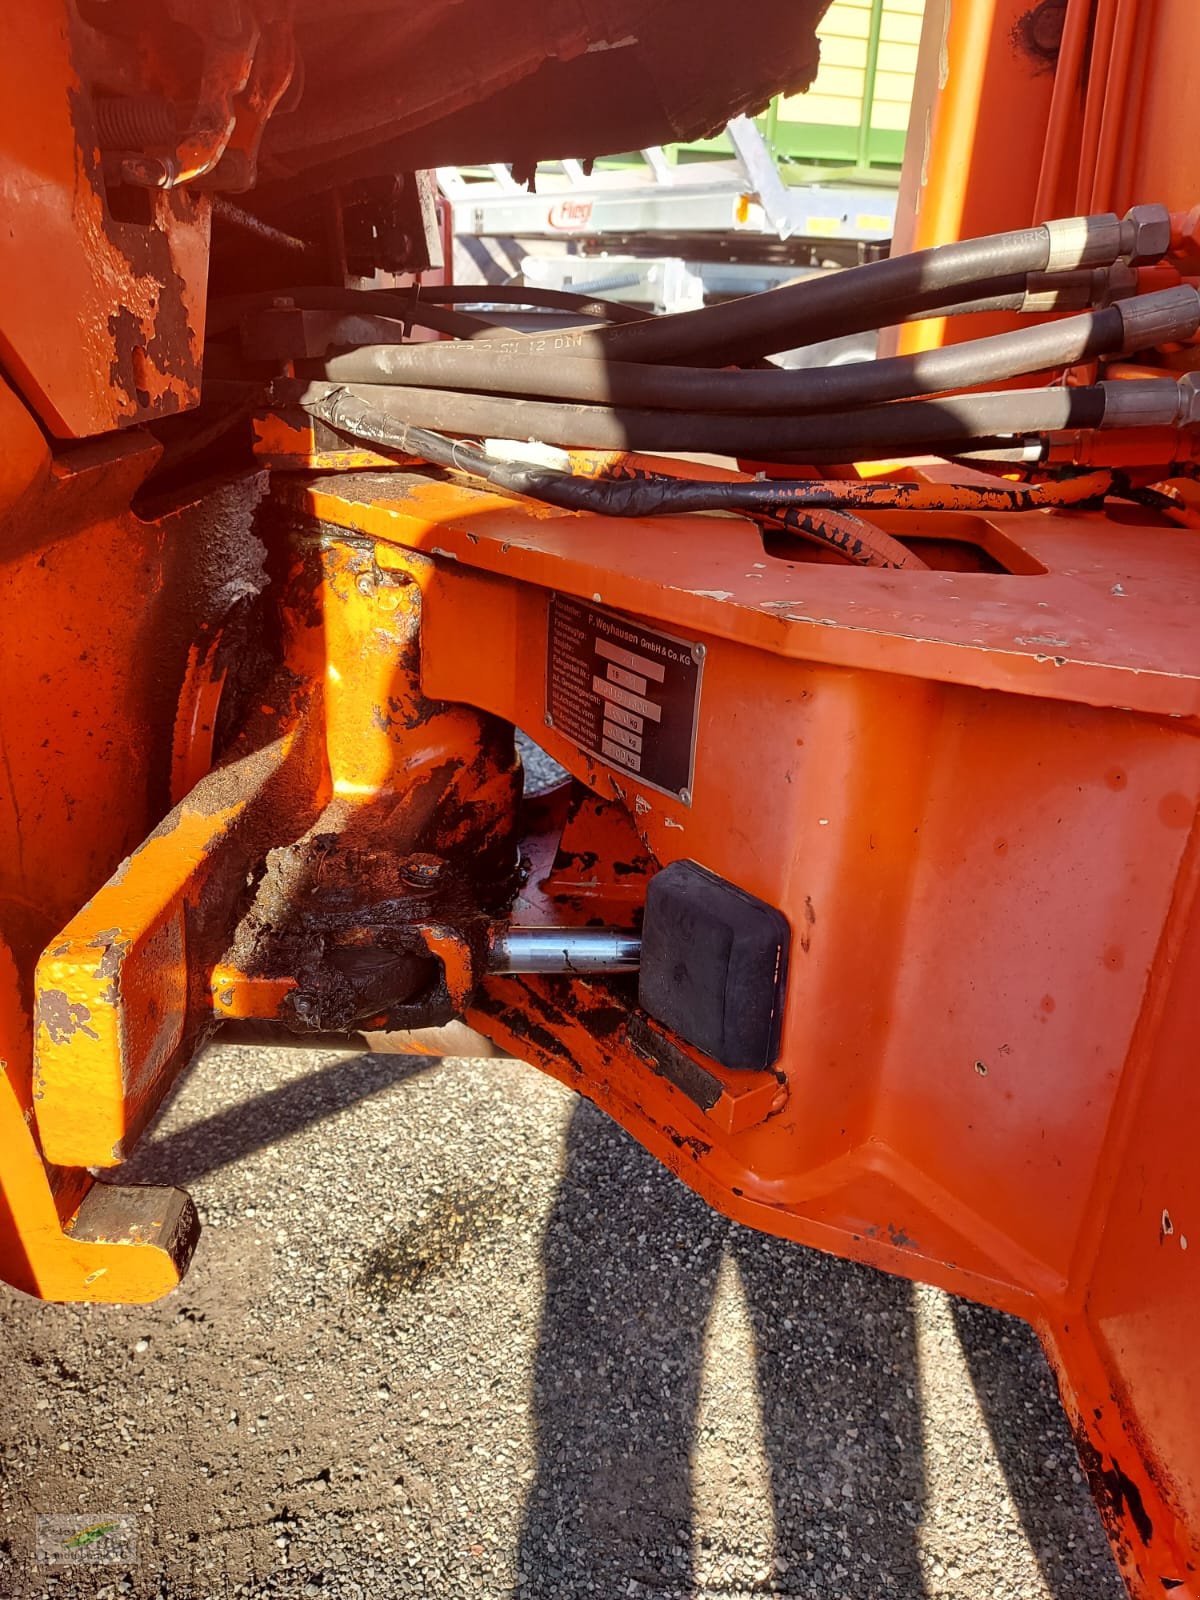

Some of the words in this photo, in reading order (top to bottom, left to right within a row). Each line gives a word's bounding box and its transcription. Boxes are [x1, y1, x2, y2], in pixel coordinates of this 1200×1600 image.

[529, 340, 546, 351] 12
[554, 335, 582, 349] DIN
[588, 613, 596, 627] F.
[596, 616, 638, 645] Weyhausen
[640, 638, 661, 654] GmbH
[661, 646, 667, 656] &
[668, 649, 679, 661] Co.
[680, 654, 691, 665] KG
[629, 719, 638, 729] kg
[628, 735, 636, 748] kg
[627, 754, 635, 767] kg
